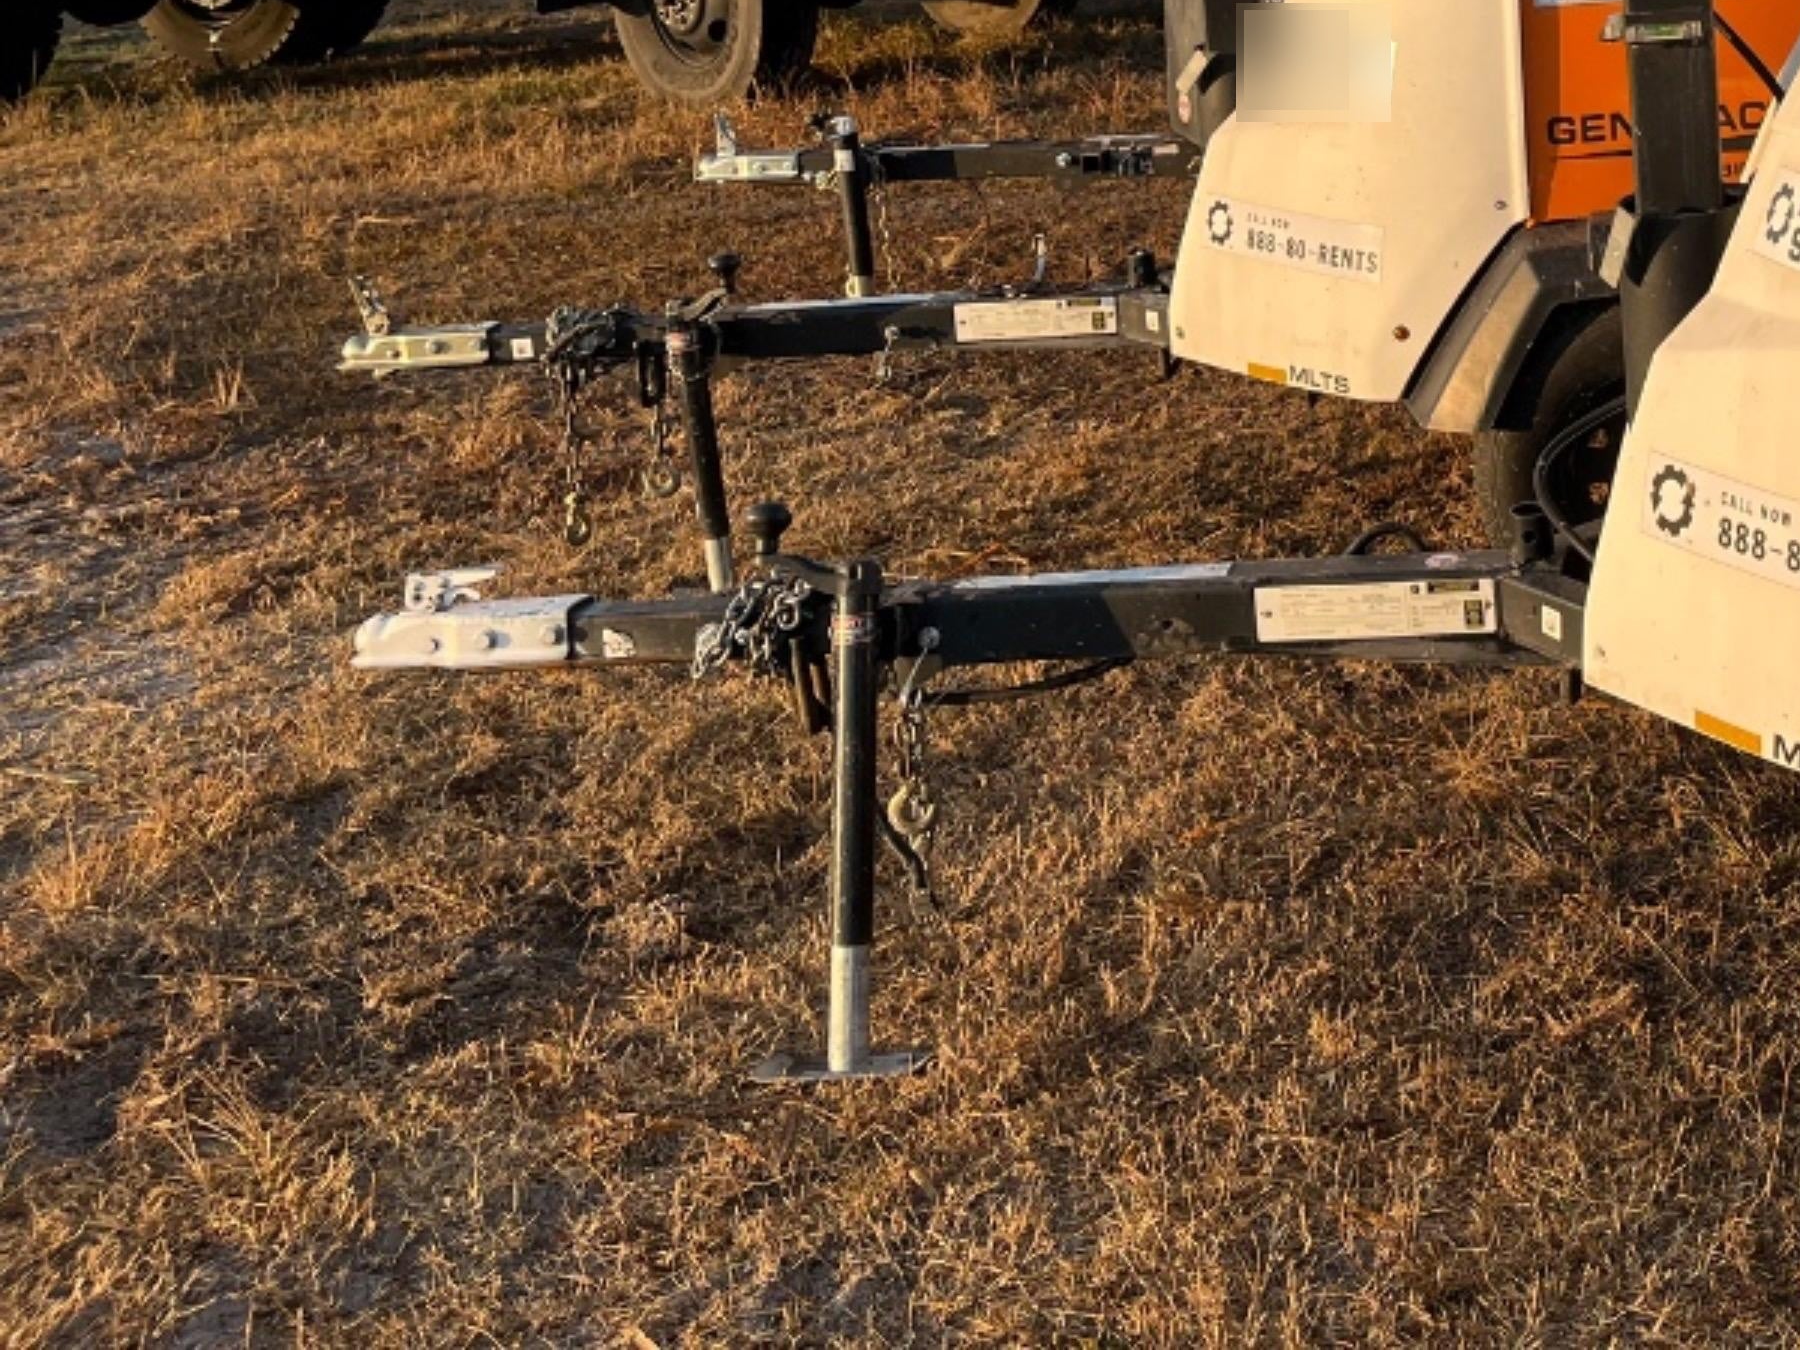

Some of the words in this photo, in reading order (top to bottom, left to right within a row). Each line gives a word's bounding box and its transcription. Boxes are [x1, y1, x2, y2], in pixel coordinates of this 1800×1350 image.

[1547, 101, 1767, 145] GENAC
[1289, 364, 1350, 394] MLTS
[1760, 503, 1792, 527] NOW
